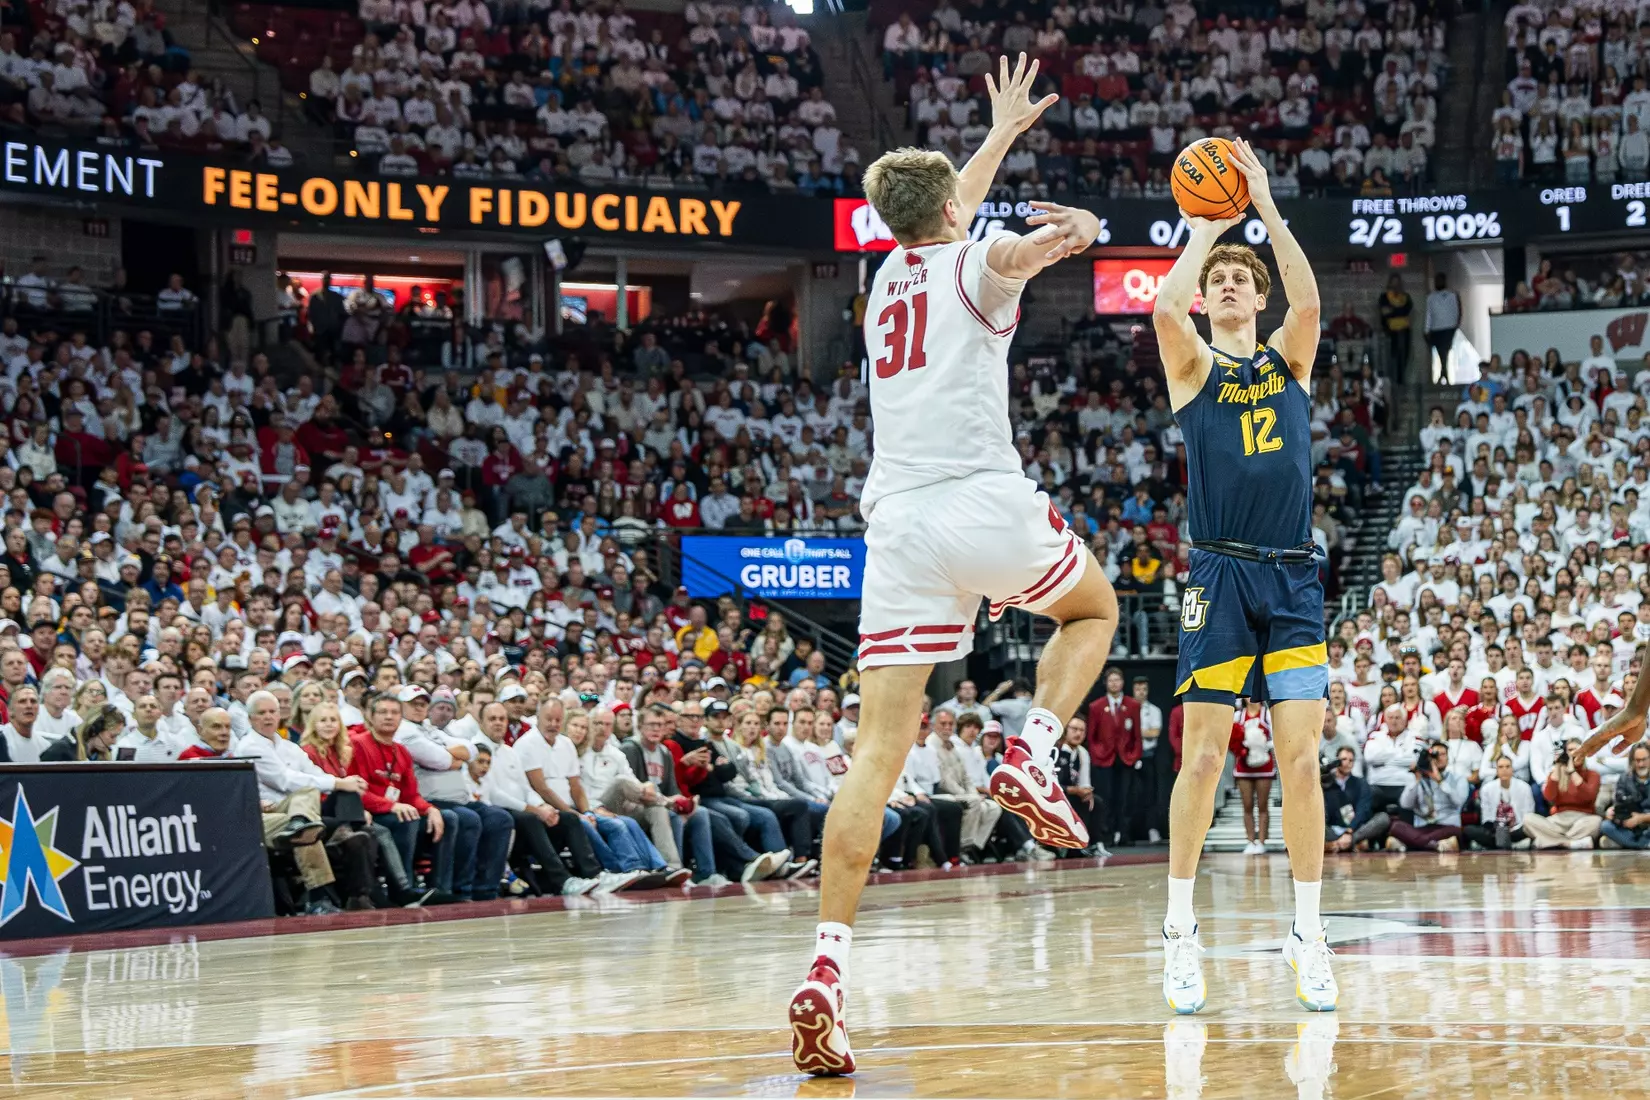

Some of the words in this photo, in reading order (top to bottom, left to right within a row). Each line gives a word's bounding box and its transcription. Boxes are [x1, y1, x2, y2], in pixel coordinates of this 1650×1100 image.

[5, 142, 164, 198] EMENT
[1178, 155, 1205, 186] NCAA
[203, 166, 449, 222] FEE-ONLY
[469, 187, 741, 236] FIDUCIARY
[1352, 199, 1395, 214] FREE
[1397, 194, 1467, 214] THROWS
[1540, 187, 1586, 205] OREB
[1626, 200, 1646, 226] 2
[1349, 216, 1403, 247] 2/2
[1421, 212, 1501, 241] 100%
[1555, 206, 1570, 231] 1
[1123, 269, 1165, 302] Qu
[876, 291, 928, 379] 31
[1240, 407, 1284, 456] 12
[740, 564, 851, 588] GRUBER
[1181, 586, 1211, 632] MU
[81, 804, 201, 859] Alliant
[83, 865, 202, 914] Energy
